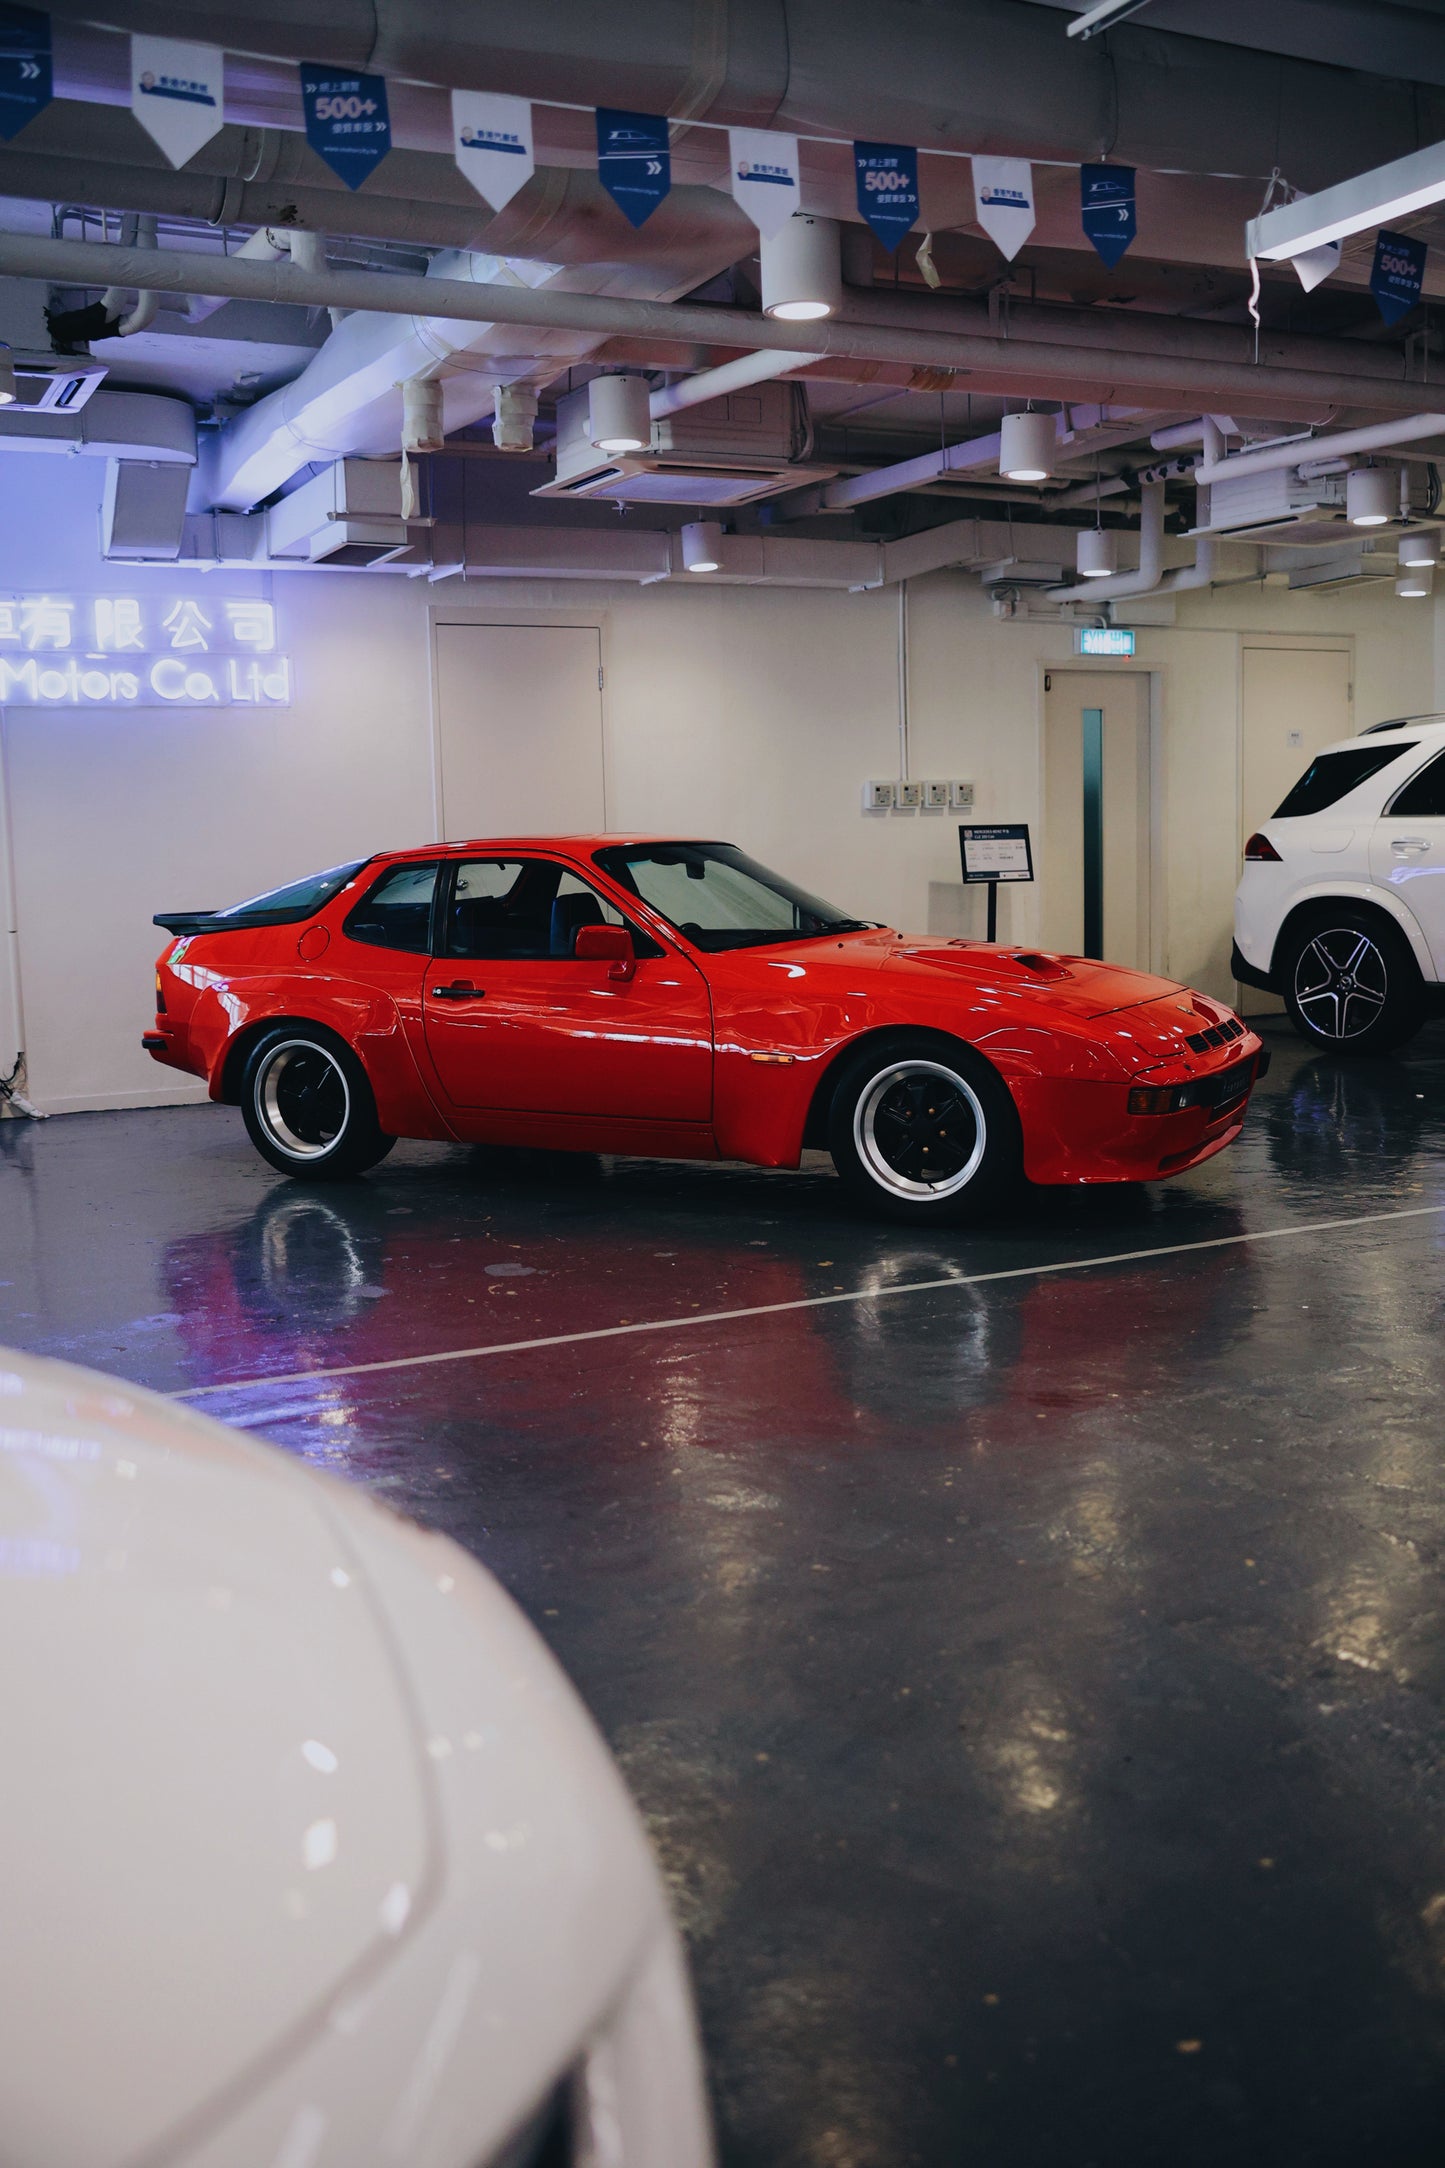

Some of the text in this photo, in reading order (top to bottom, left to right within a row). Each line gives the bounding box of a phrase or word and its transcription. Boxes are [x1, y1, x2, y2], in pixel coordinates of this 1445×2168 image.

[315, 96, 378, 120] 500+
[865, 171, 910, 191] 500+
[1381, 255, 1417, 275] 500+
[1081, 630, 1133, 655] EXIT 出口
[0, 657, 140, 702] Motors
[229, 658, 289, 703] Ltd
